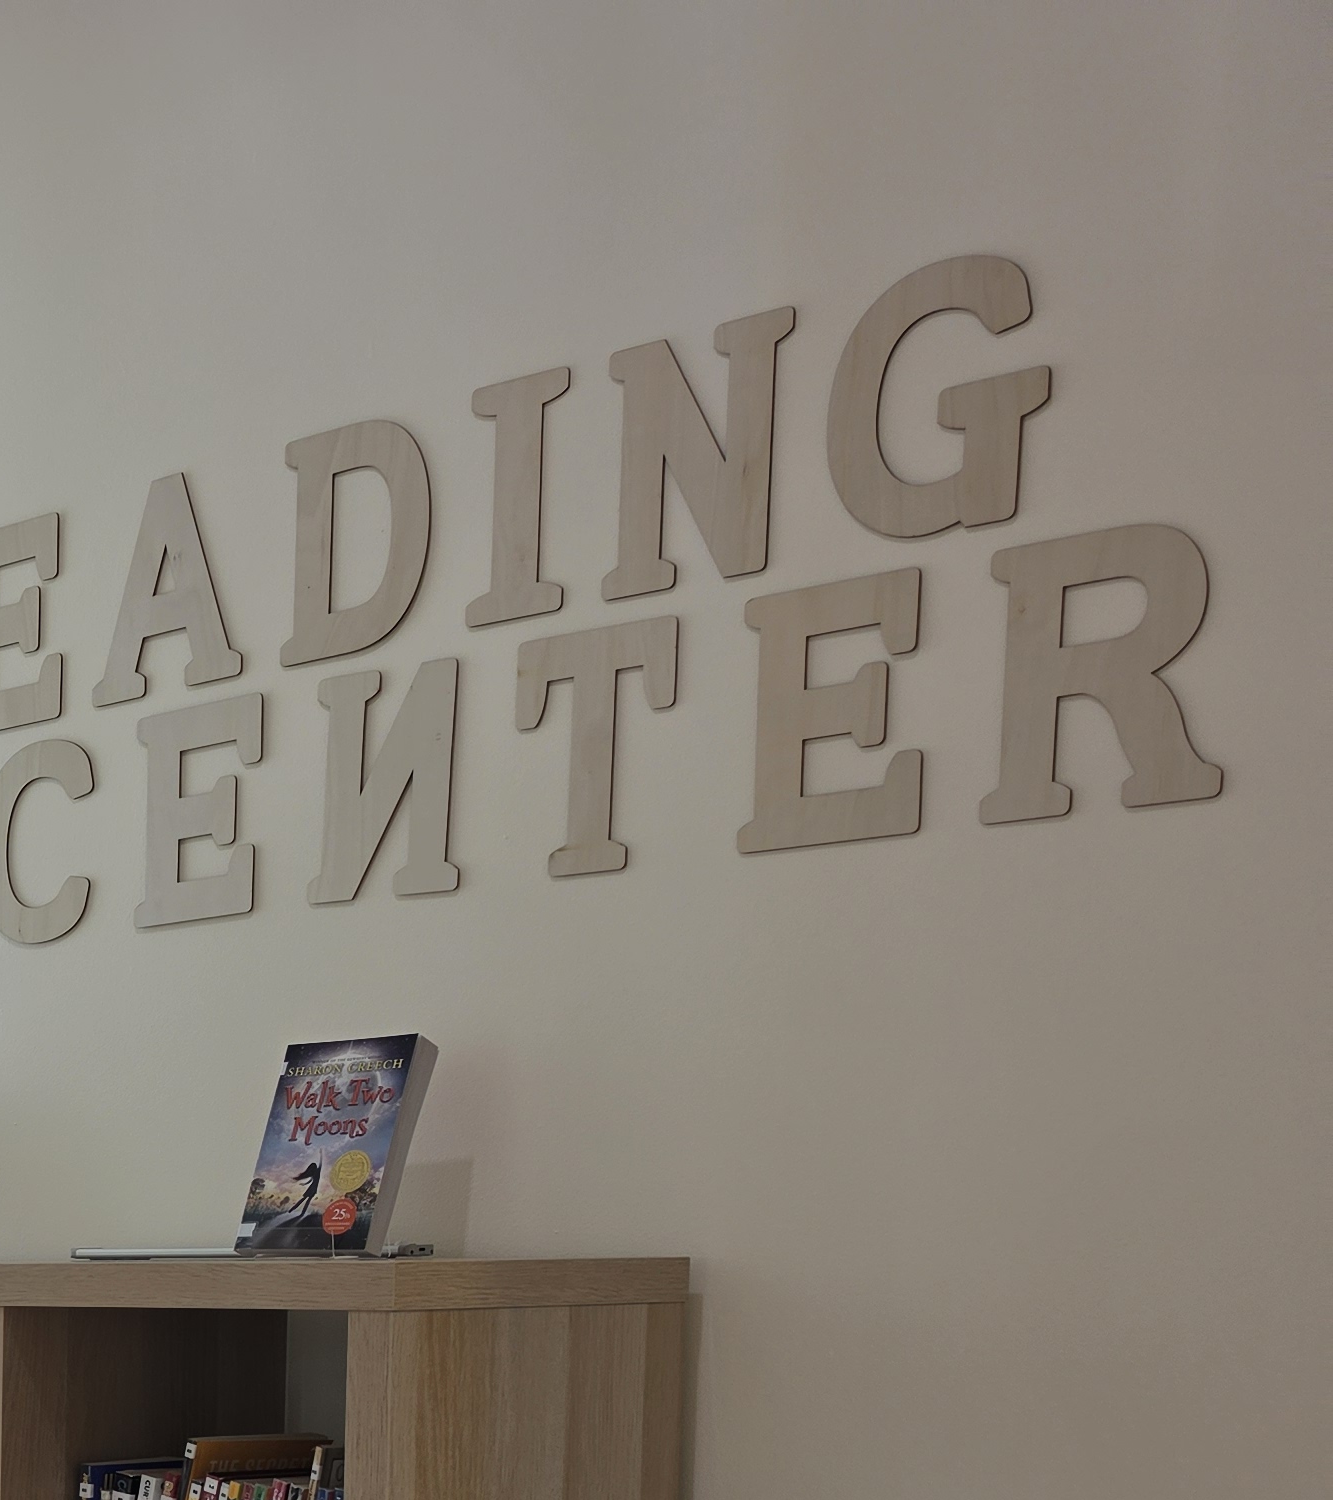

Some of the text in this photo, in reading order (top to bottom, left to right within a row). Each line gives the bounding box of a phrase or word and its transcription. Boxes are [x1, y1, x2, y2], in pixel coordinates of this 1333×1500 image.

[287, 1063, 344, 1077] SHARON
[347, 1058, 404, 1072] CREECH
[285, 1078, 395, 1113] Walk Two
[288, 1115, 370, 1146] Moons
